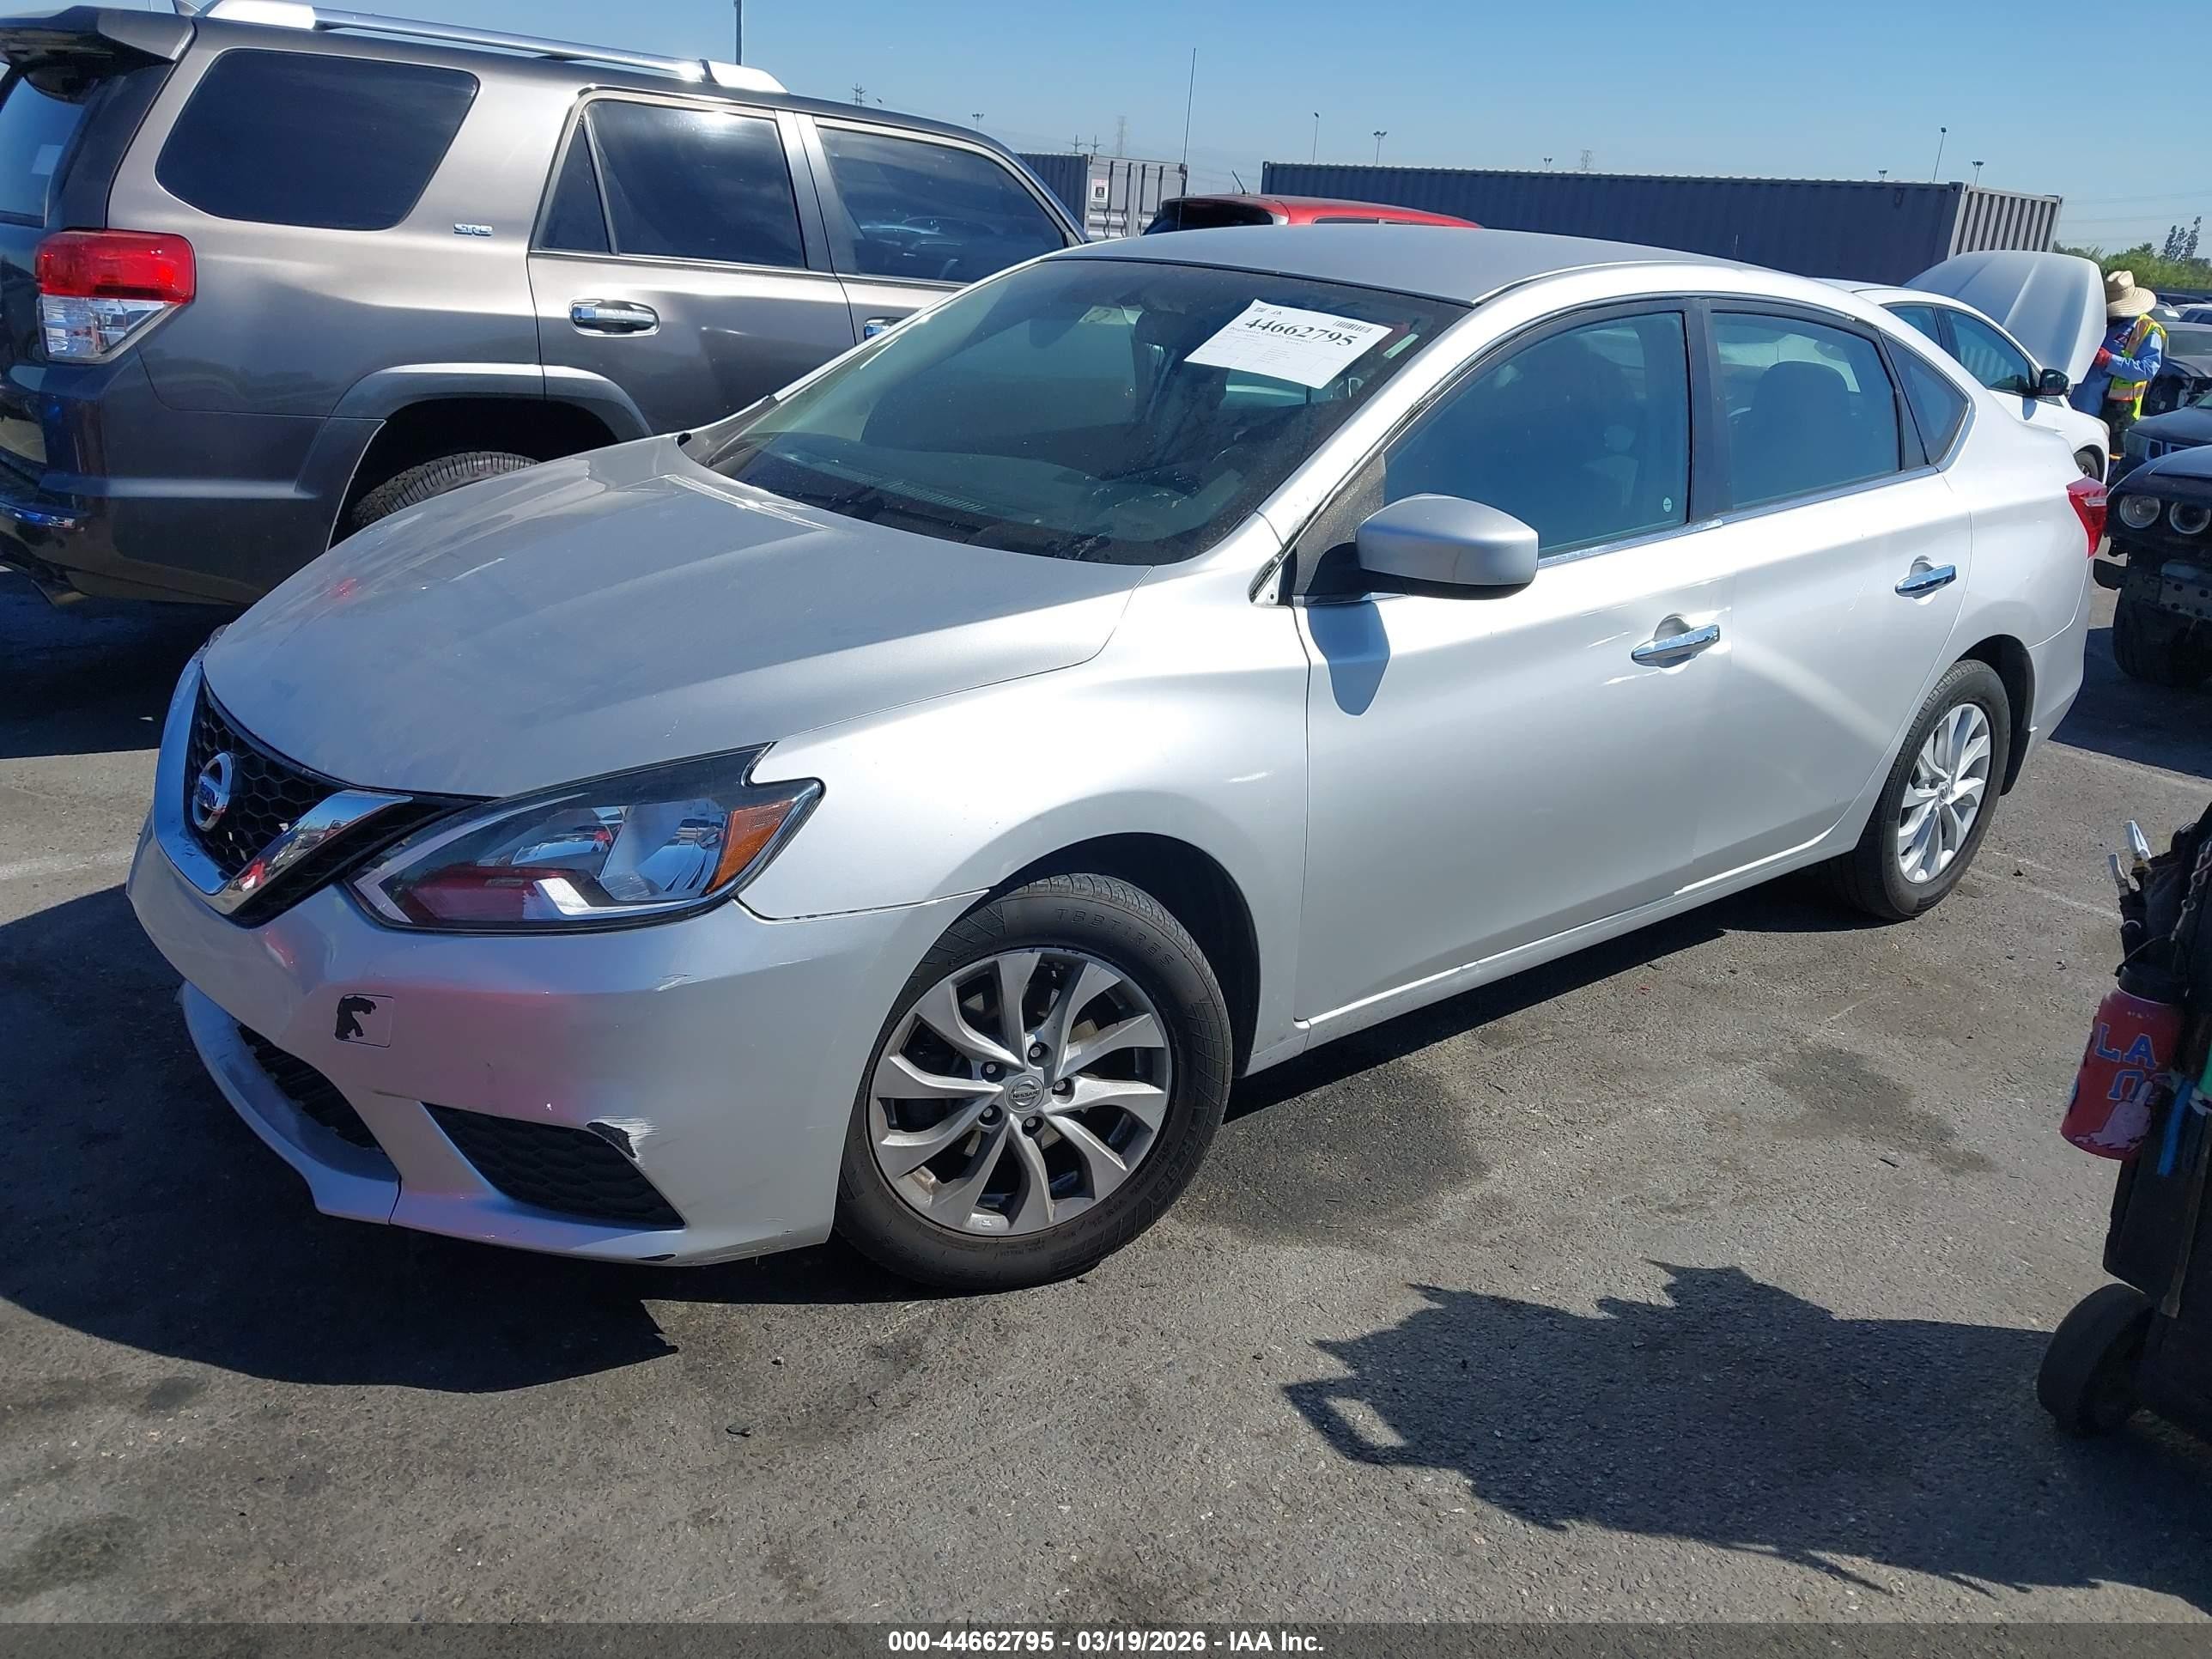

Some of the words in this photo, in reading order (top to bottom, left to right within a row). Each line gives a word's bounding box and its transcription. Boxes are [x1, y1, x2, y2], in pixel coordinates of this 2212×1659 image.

[1244, 317, 1359, 347] 44662795
[2094, 1022, 2158, 1070] LA
[1012, 1091, 1039, 1099] NISSAN
